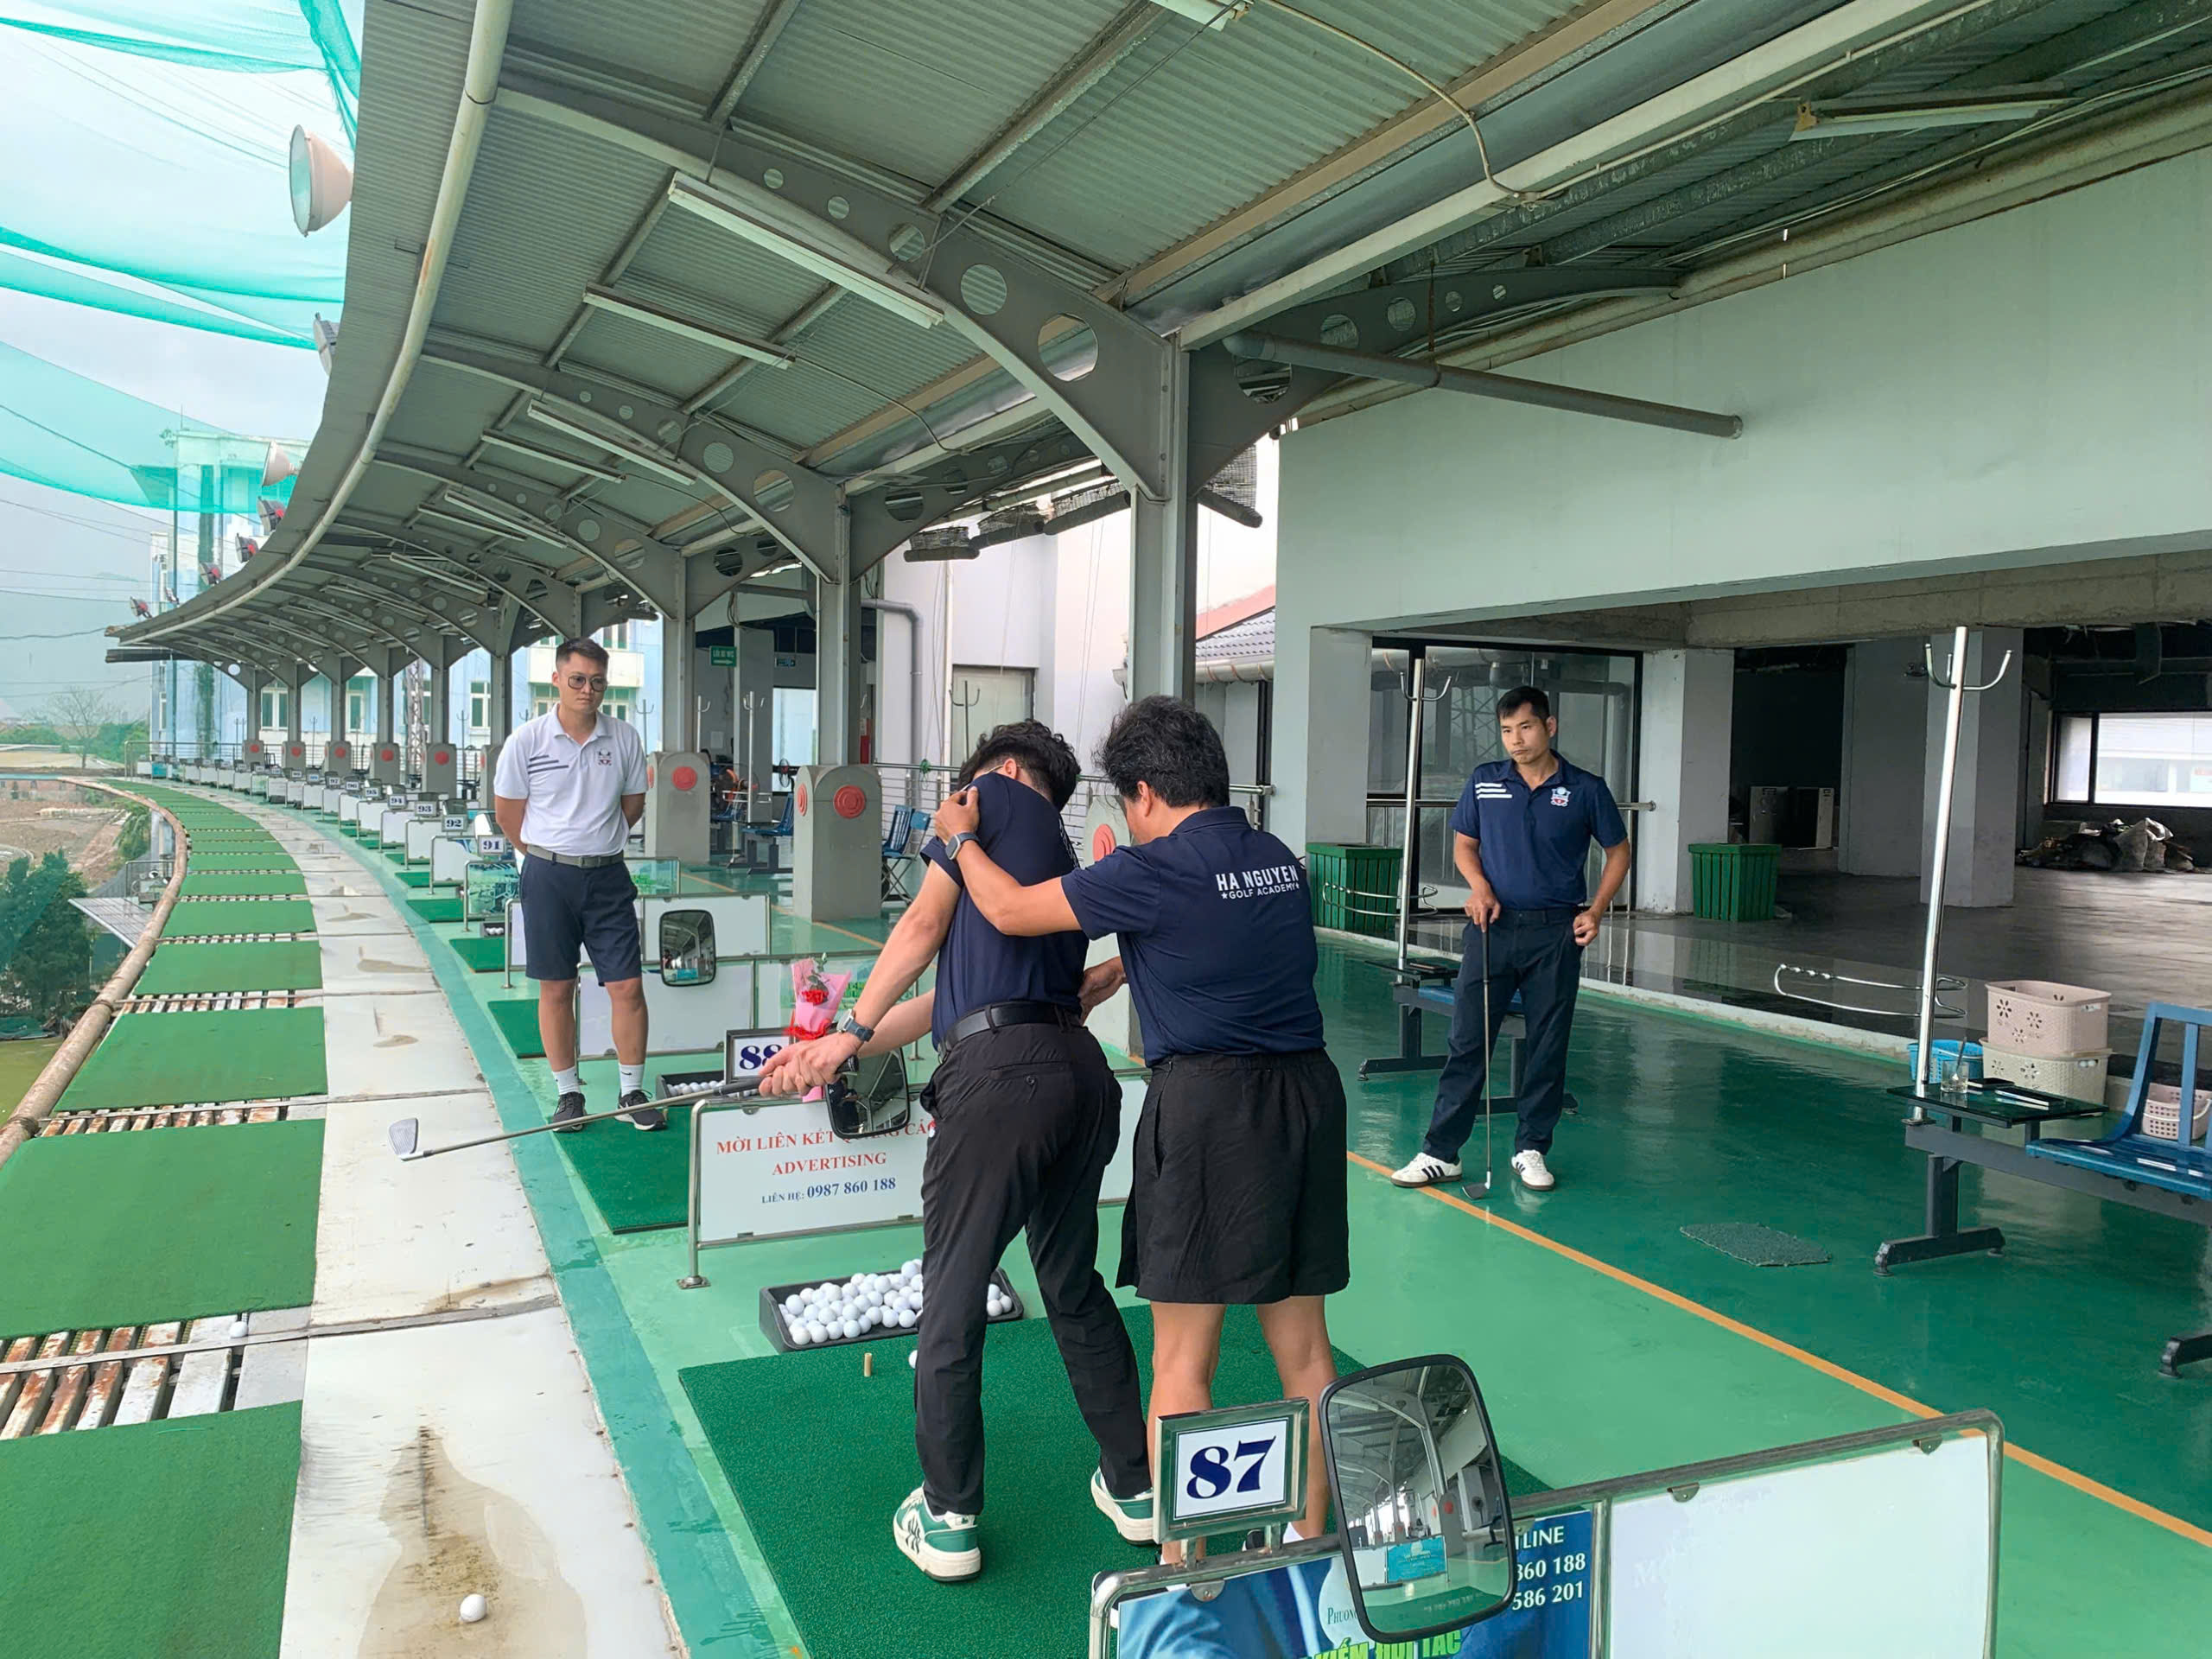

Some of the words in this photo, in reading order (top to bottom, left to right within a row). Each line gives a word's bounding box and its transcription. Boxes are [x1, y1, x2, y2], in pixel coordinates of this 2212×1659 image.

[417, 804, 432, 813] 93
[446, 818, 462, 828] 92
[483, 841, 500, 850] 91
[1216, 873, 1240, 891] HA
[1242, 865, 1299, 888] NGUYEN
[1229, 889, 1254, 899] GOLF
[1257, 882, 1295, 896] ACADEMY
[717, 1135, 751, 1154] MỜI
[757, 1131, 797, 1150] LIÊN
[772, 1152, 887, 1175] ADVERTISING
[762, 1191, 785, 1204] LIÊN
[807, 1183, 840, 1198] 0987
[843, 1180, 868, 1194] 860
[874, 1177, 896, 1191] 188
[1186, 1435, 1277, 1499] 87
[1515, 1526, 1564, 1550] LINE
[1553, 1553, 1586, 1575] 188
[1512, 1587, 1546, 1611] 586
[1552, 1580, 1583, 1603] 201
